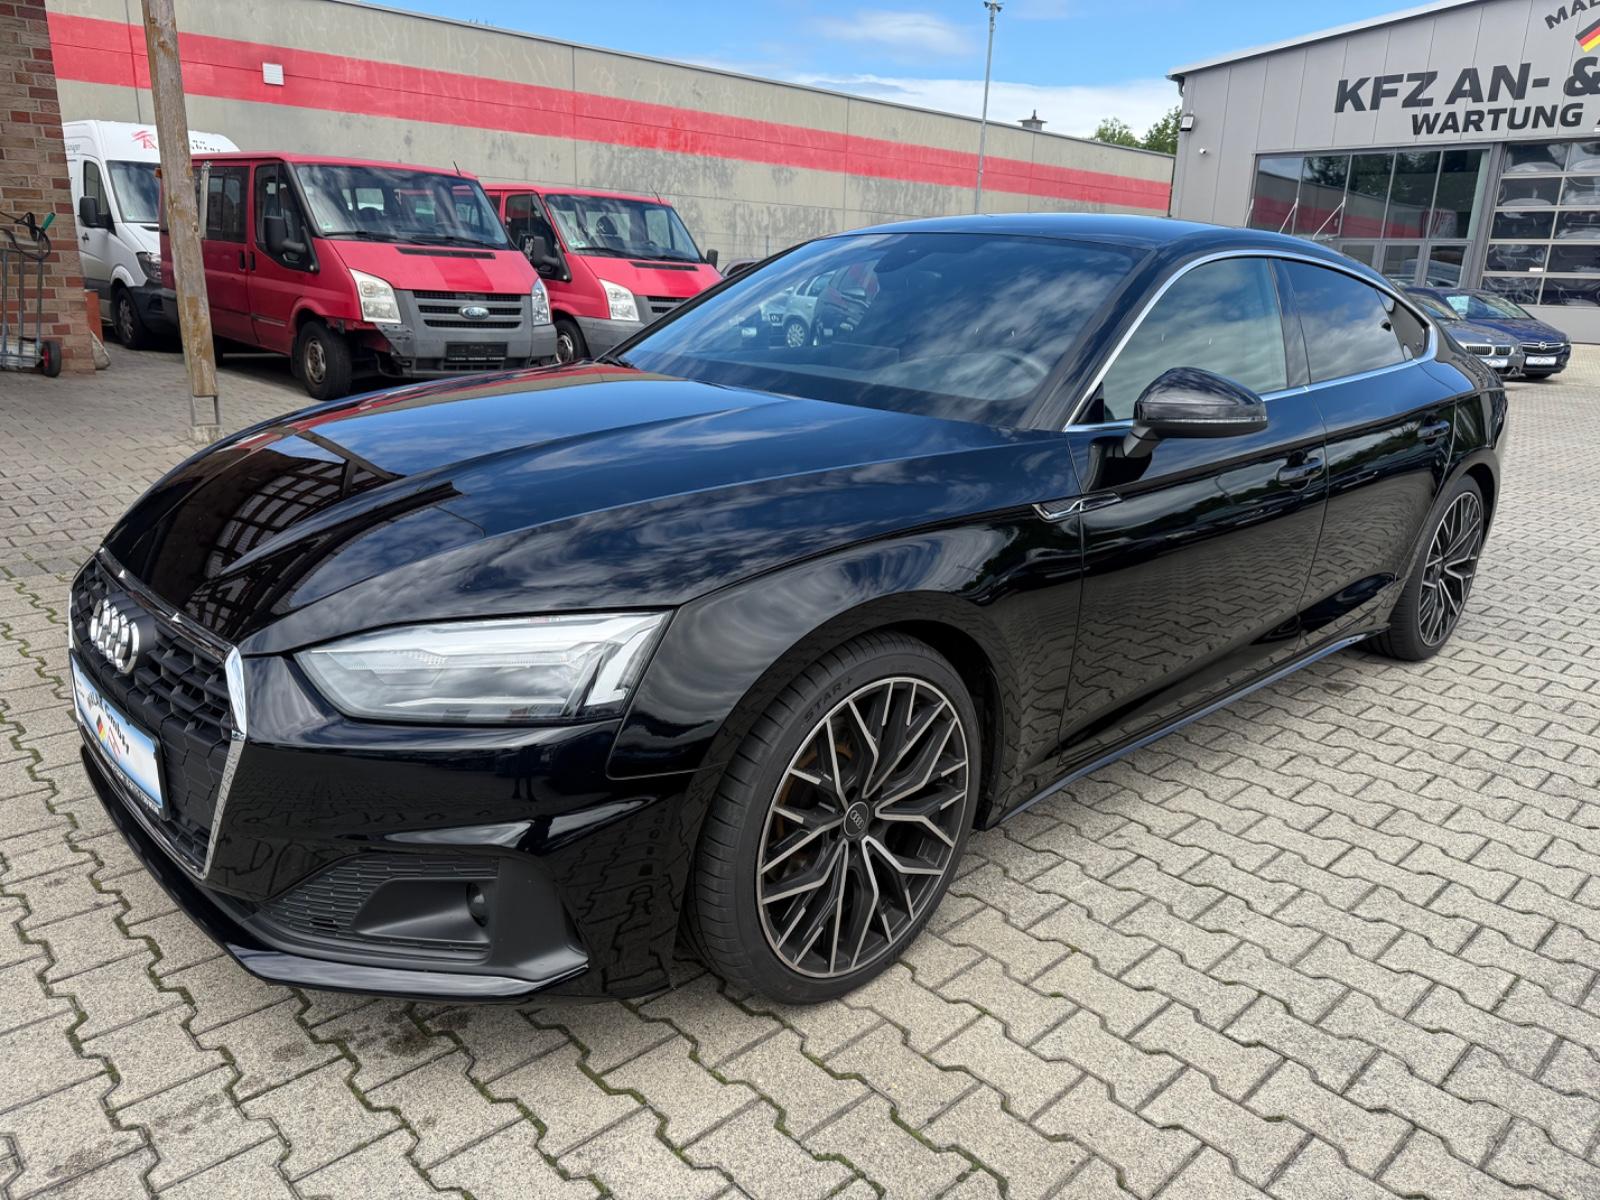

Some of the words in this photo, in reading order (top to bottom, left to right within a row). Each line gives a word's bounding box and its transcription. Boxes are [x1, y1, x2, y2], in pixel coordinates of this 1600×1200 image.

[1334, 71, 1438, 113] KFZ
[1445, 63, 1550, 104] AN-
[1563, 56, 1600, 97] &
[1412, 103, 1584, 135] WARTUNG
